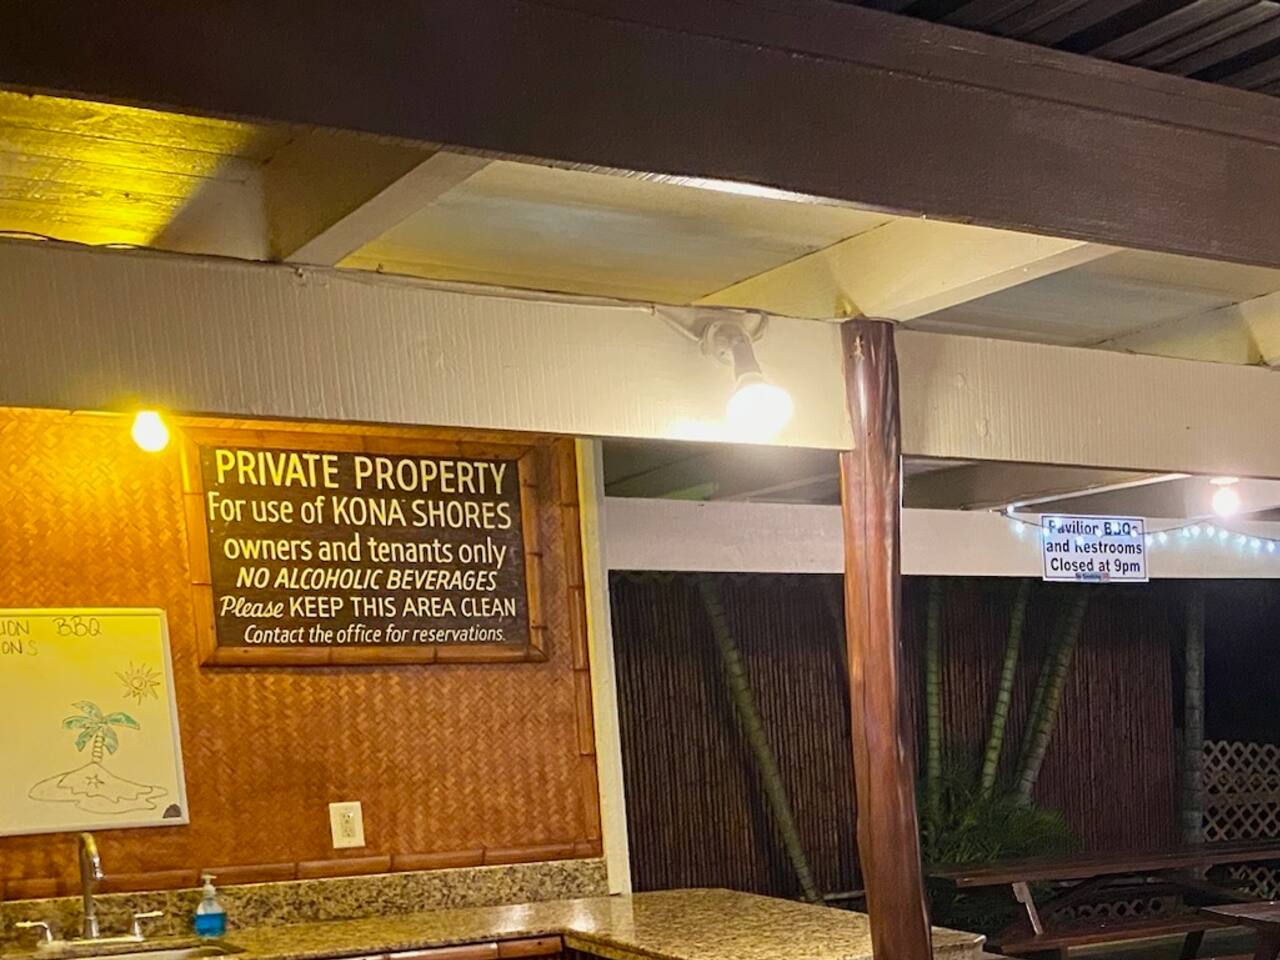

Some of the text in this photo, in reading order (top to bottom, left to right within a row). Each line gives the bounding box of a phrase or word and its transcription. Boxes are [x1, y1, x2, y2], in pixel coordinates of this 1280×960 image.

[215, 449, 507, 495] PRIVATE PROPERTY
[207, 491, 512, 530] For use of KONA SHORES
[1104, 521, 1138, 536] BQ
[223, 532, 507, 569] owners and tenants only
[1046, 539, 1070, 553] and
[1050, 558, 1140, 575] Closed at 9pm
[236, 567, 498, 592] NO ALCOHOLIC BEVERAGES
[219, 595, 517, 618] Please KEEP THIS AREA CLEAN
[52, 615, 102, 637] BBQ
[244, 624, 307, 644] Contact
[308, 624, 334, 643] the
[336, 624, 383, 644] office
[385, 624, 410, 643] for
